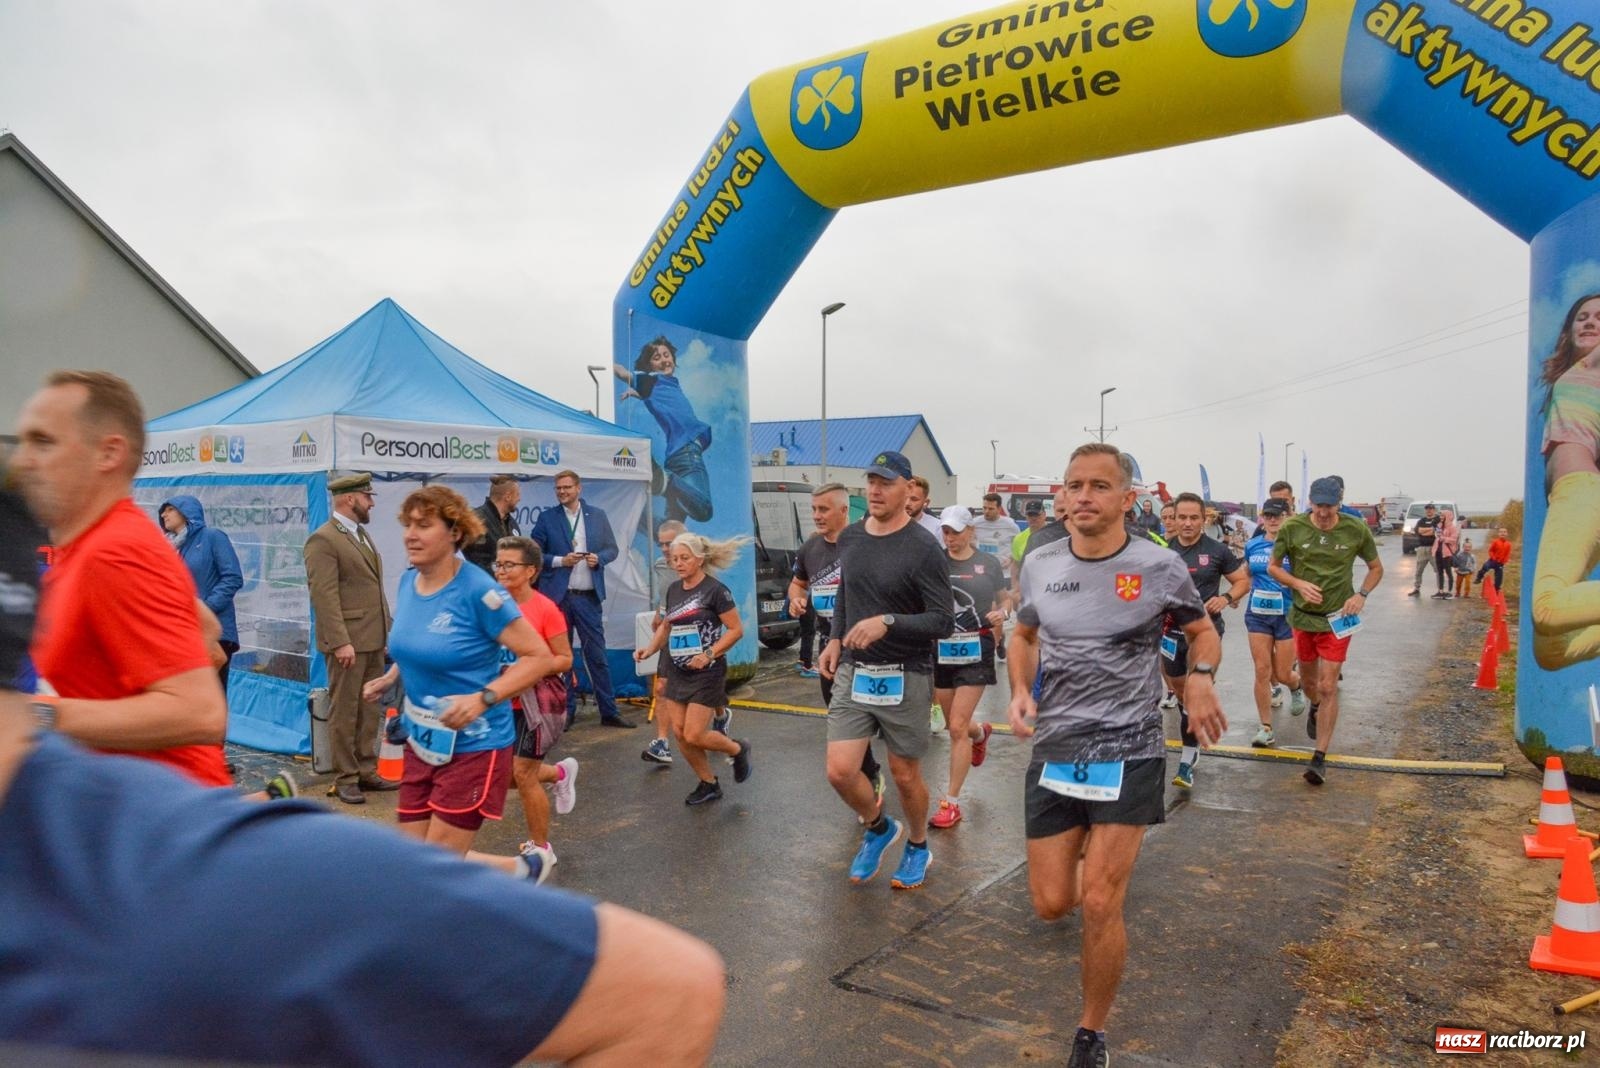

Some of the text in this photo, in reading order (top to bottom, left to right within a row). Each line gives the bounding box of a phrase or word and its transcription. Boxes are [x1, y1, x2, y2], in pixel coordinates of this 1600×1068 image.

[894, 15, 1155, 99] Pietrowice
[1541, 22, 1600, 94] lu
[925, 66, 1121, 132] Wielkie
[1363, 0, 1600, 179] aktywnych
[629, 119, 741, 288] Gmina ludzi
[650, 147, 765, 309] aktywnych
[142, 442, 196, 466] sonalBest
[292, 443, 317, 458] MITKO
[361, 431, 491, 460] PersonalBest
[612, 456, 637, 468] MITKO
[1045, 582, 1080, 593] ADAM
[1260, 598, 1273, 609] 68
[673, 635, 690, 649] 71
[950, 643, 969, 656] 56
[868, 677, 889, 695] 36
[1073, 761, 1089, 783] 8
